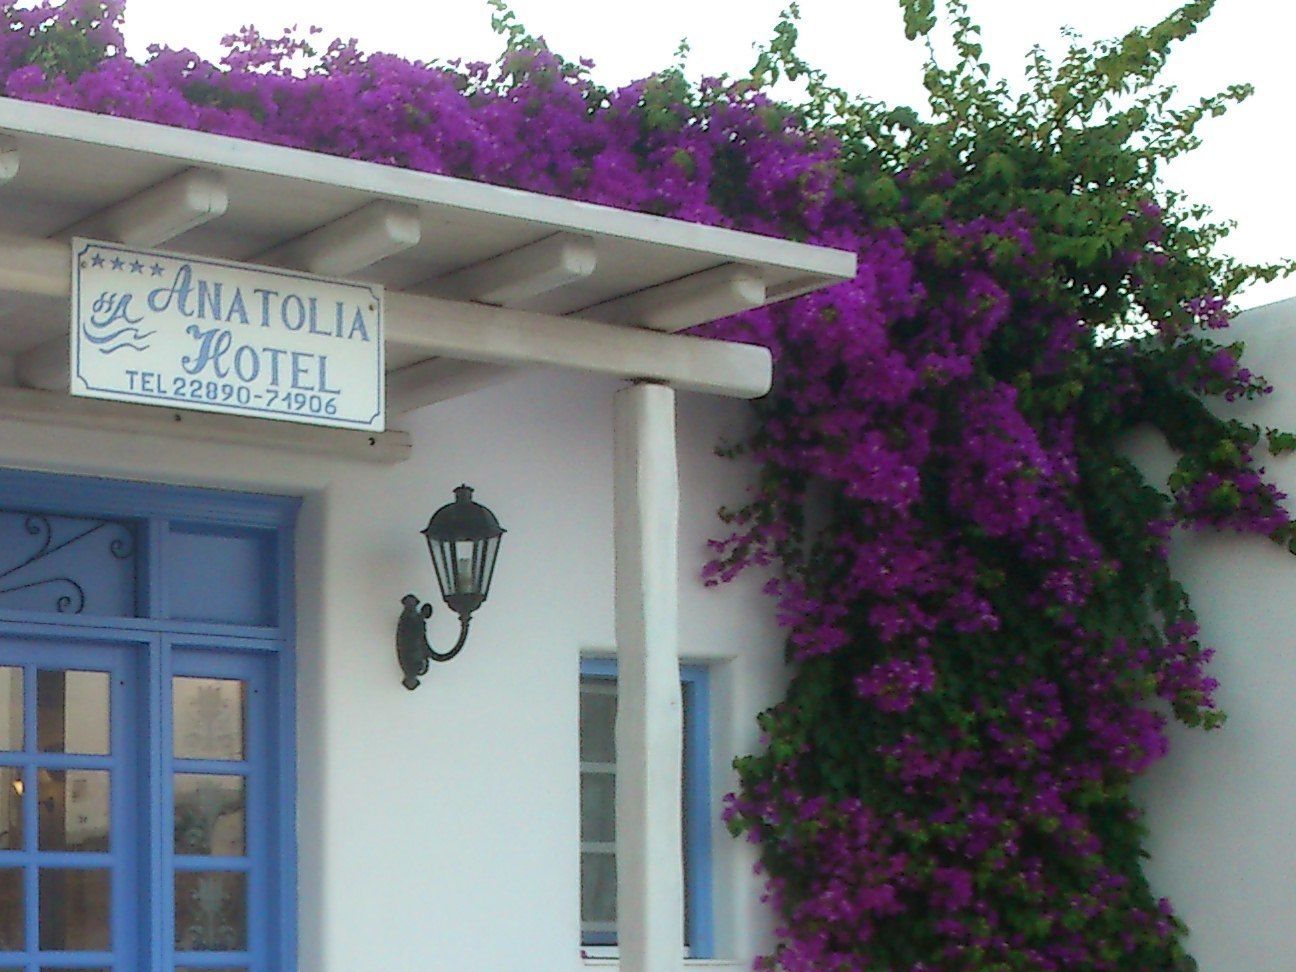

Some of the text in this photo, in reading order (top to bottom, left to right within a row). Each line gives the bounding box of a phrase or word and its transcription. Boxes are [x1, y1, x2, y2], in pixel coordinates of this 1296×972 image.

[147, 263, 371, 342] ANATOLIA
[125, 369, 338, 415] TEL 22890-71906
[181, 324, 341, 395] HOTEL
